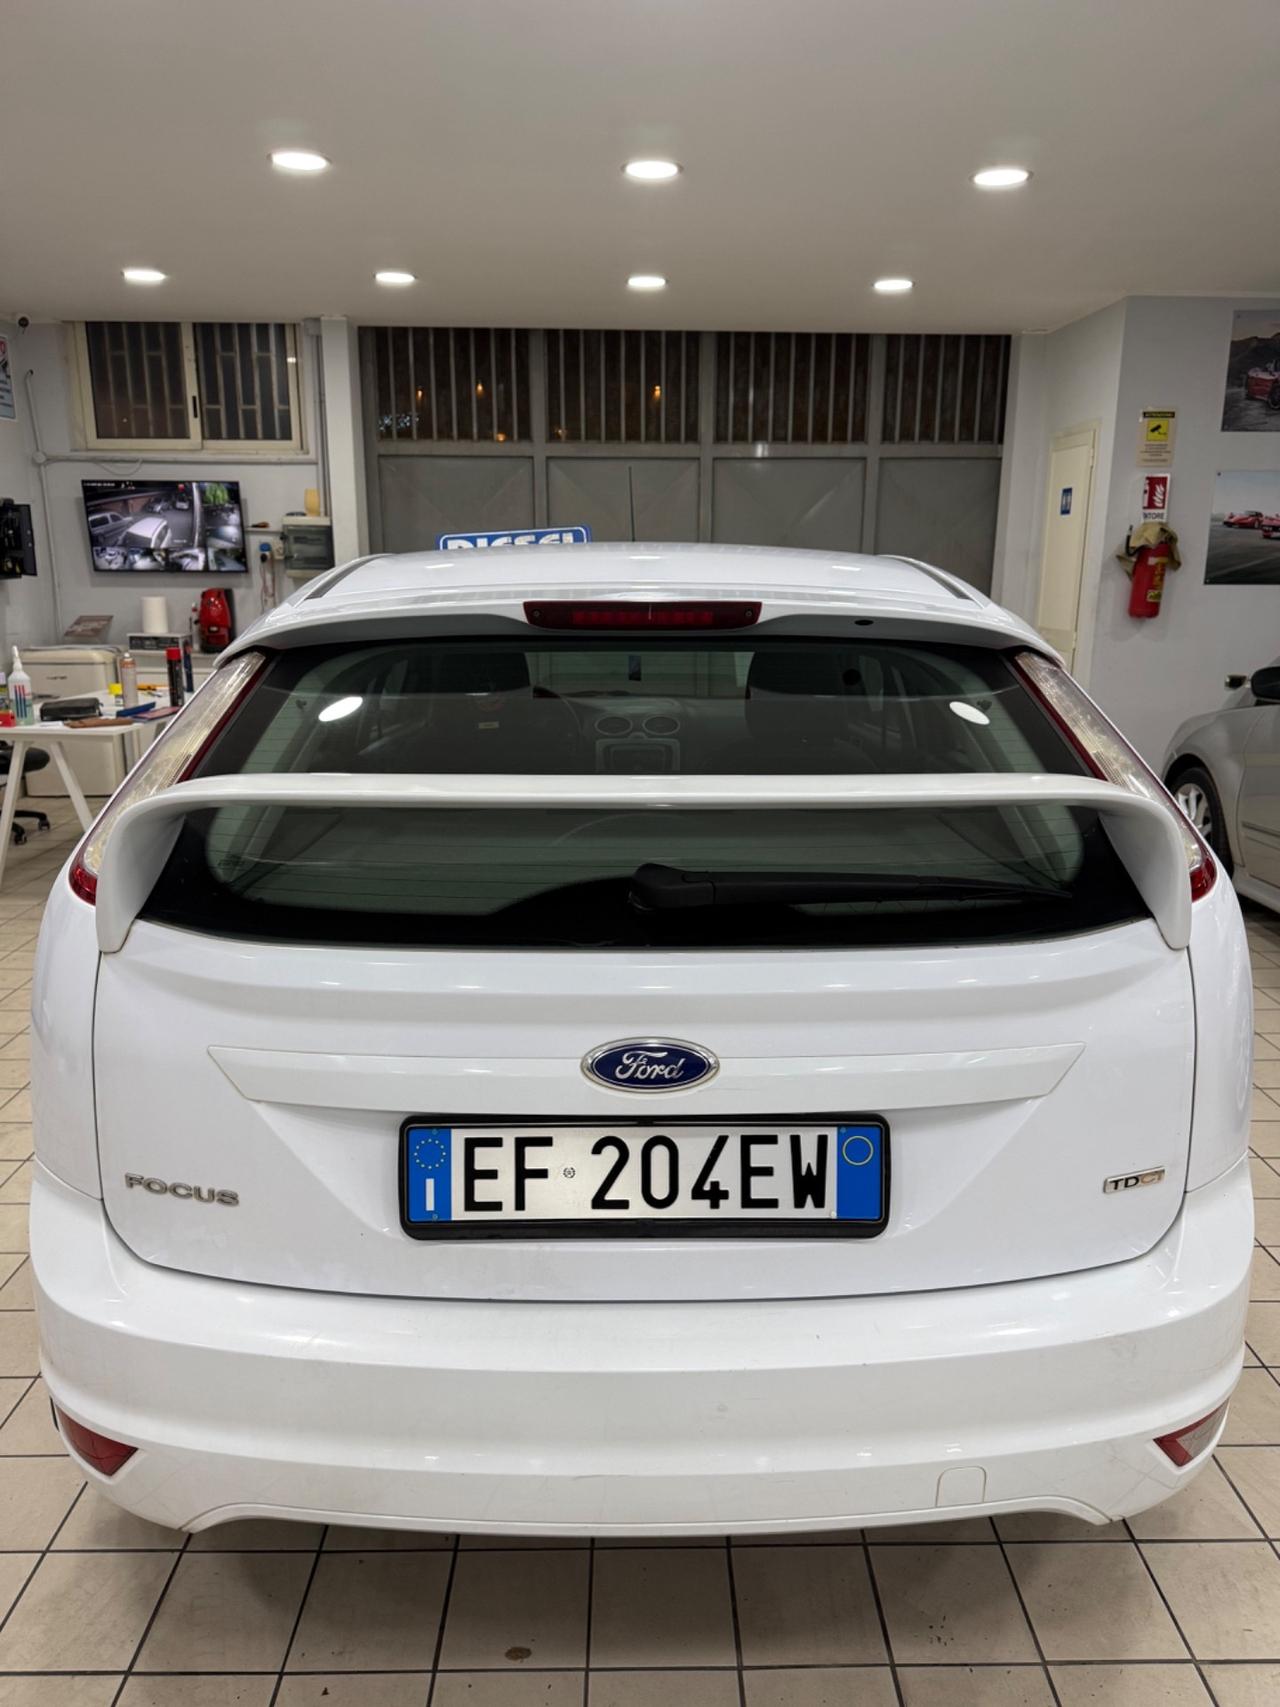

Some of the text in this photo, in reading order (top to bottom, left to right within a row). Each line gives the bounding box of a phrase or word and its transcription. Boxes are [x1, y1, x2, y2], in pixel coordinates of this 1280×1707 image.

[615, 1050, 686, 1079] Ford
[124, 1172, 240, 1208] FOCUS
[464, 1134, 829, 1212] EF 204EW
